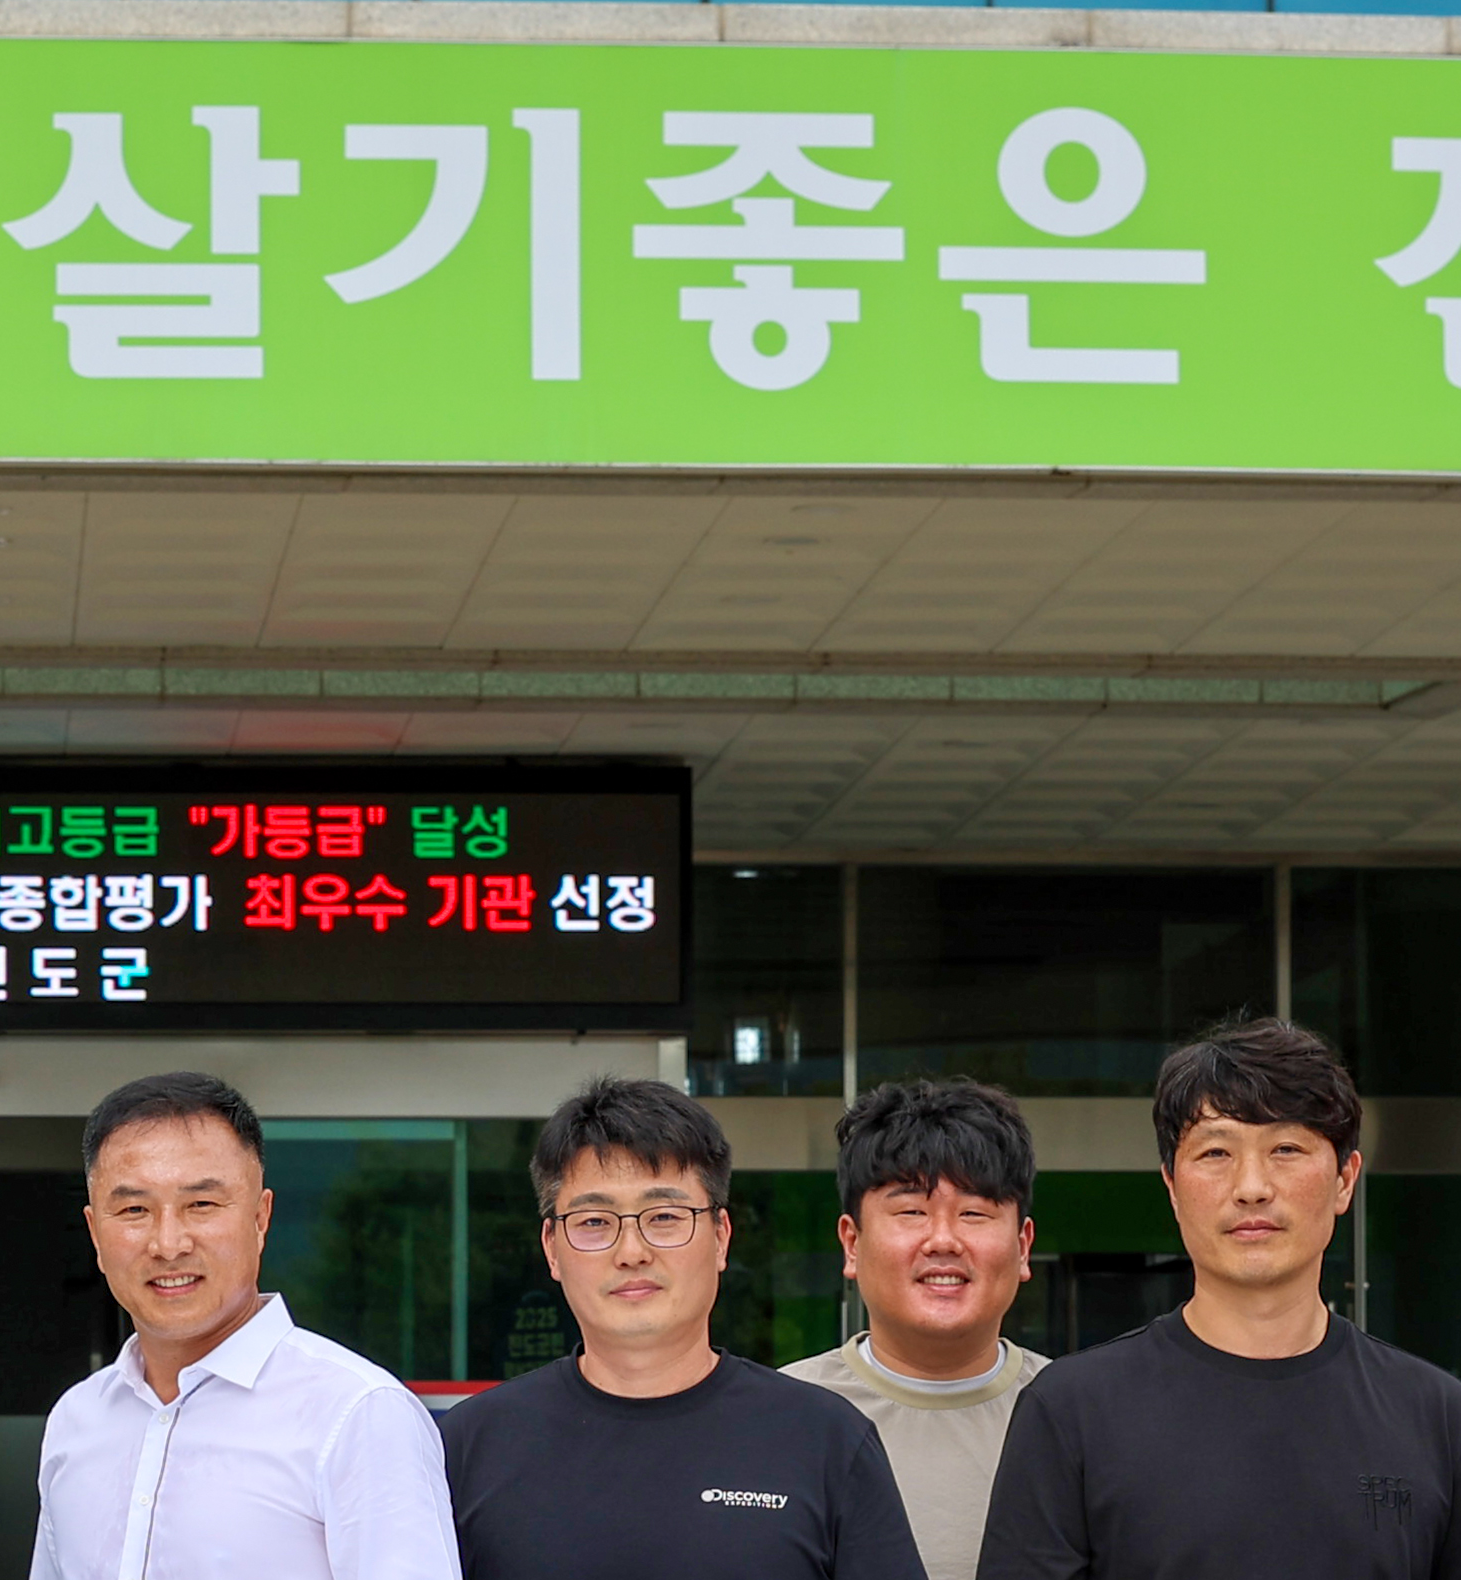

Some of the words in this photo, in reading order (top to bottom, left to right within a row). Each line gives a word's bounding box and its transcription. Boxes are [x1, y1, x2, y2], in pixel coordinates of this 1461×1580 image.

[2, 106, 1206, 390] 살기좋은
[188, 803, 387, 859] "가등급"
[411, 807, 508, 858] 달성
[243, 873, 408, 932] 최우수
[427, 874, 537, 932] 기관
[550, 875, 656, 931] 선정
[711, 1488, 789, 1510] Discovery
